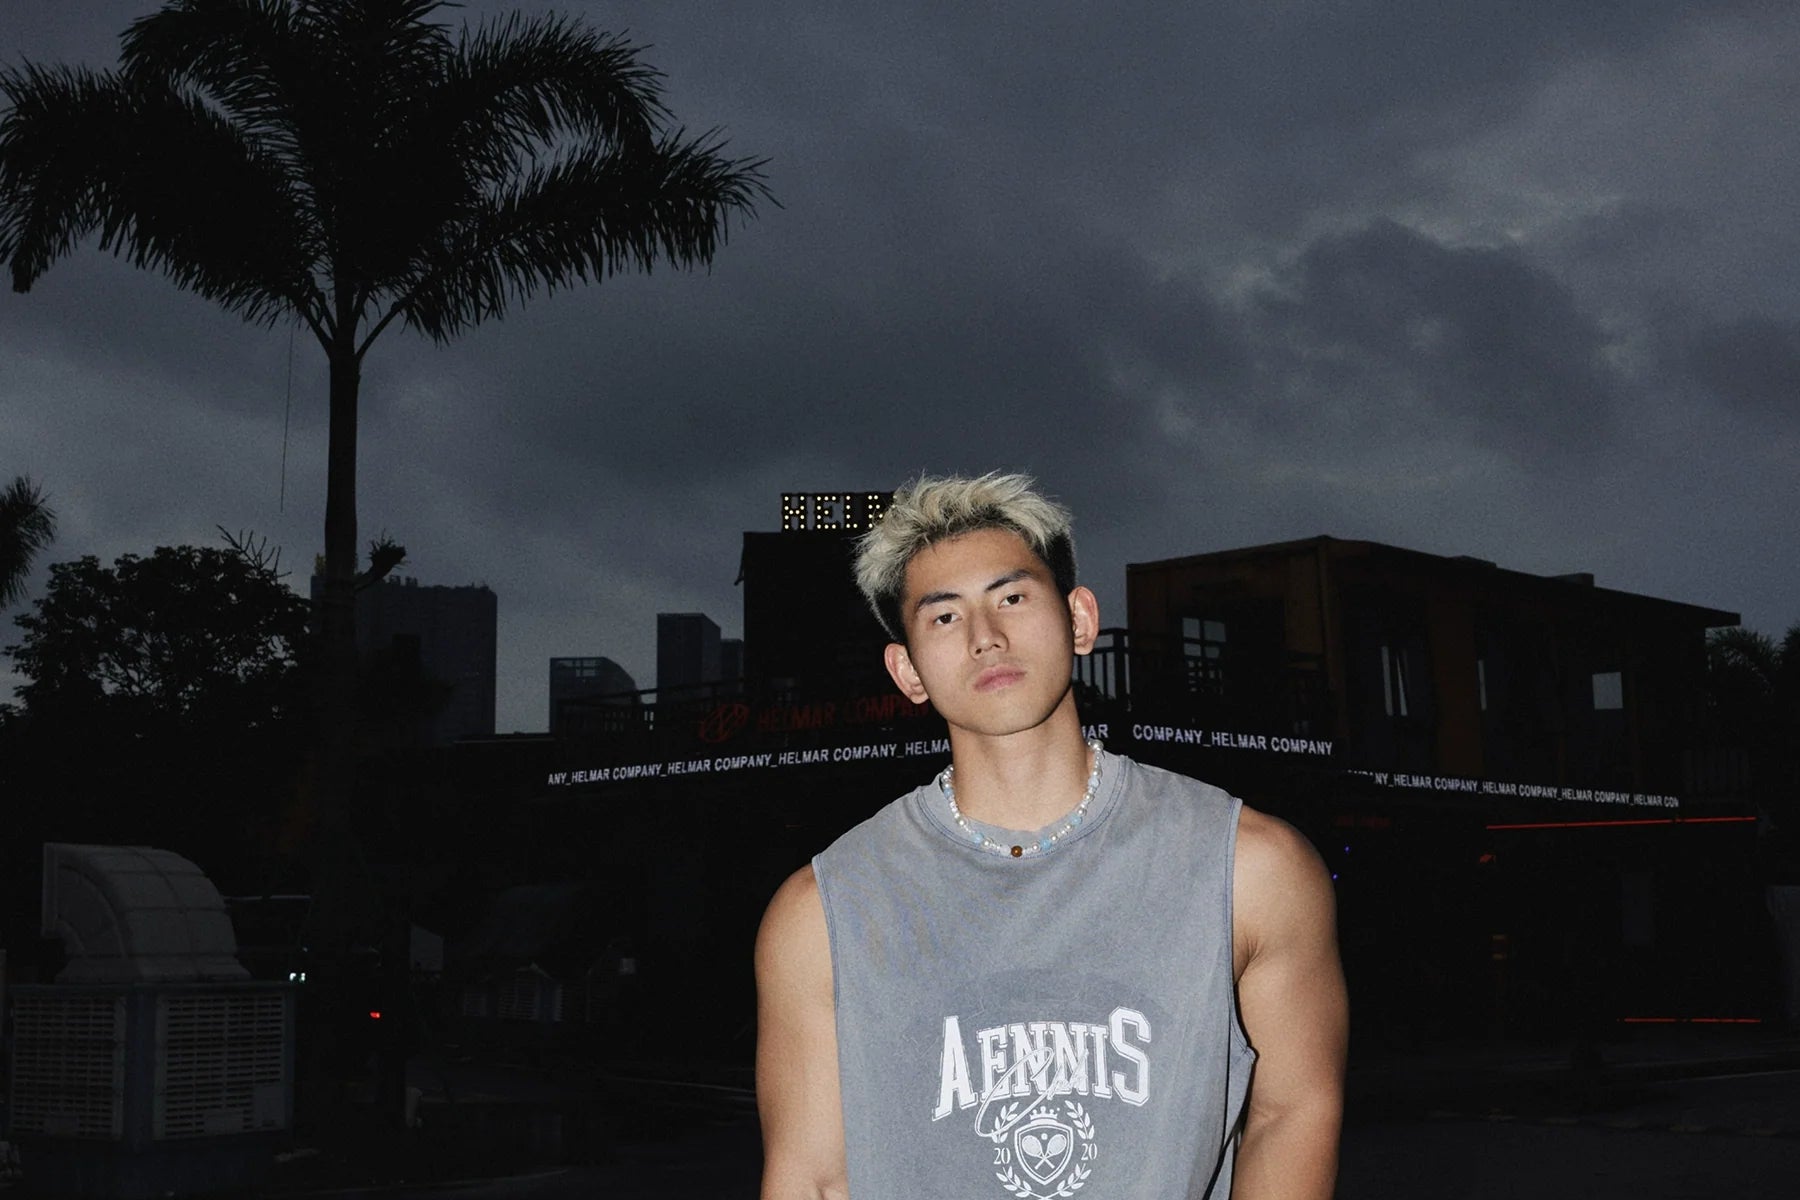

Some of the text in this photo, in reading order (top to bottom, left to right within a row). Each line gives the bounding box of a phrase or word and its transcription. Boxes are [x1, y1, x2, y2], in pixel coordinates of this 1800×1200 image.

[781, 493, 897, 531] HELM
[833, 738, 951, 762] COMPANY_HELMA
[1271, 736, 1333, 756] COMPANY
[932, 1006, 1151, 1121] AENNIS
[993, 1143, 1098, 1165] 20 20
